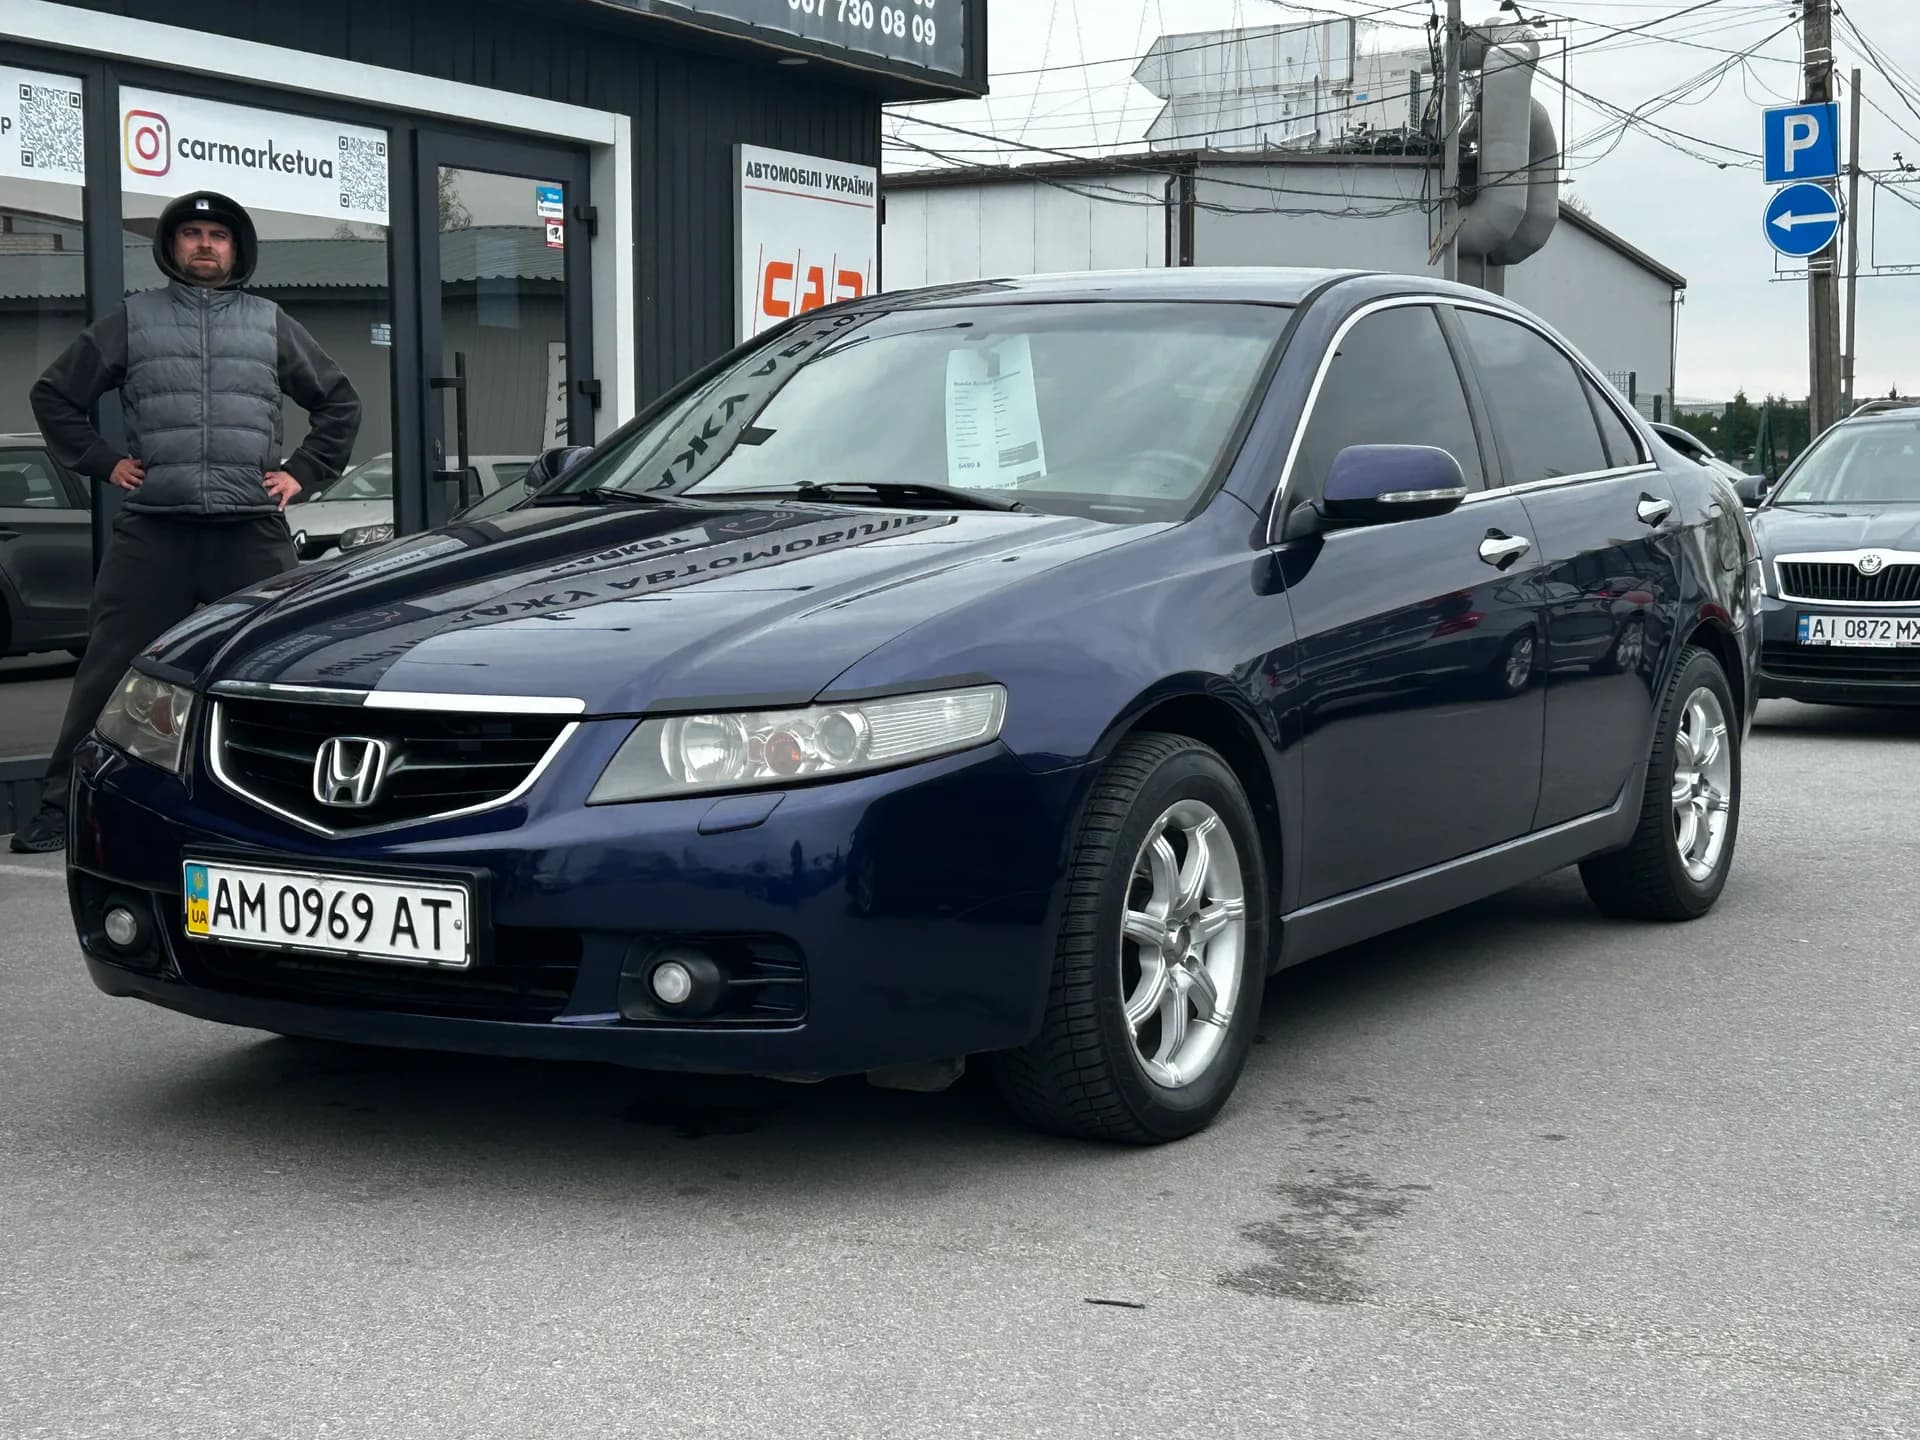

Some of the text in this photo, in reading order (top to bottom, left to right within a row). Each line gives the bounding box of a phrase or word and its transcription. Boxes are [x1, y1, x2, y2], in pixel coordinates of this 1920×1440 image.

[837, 0, 874, 30] 730
[880, 5, 906, 38] 08
[911, 14, 936, 46] 09
[177, 135, 334, 180] carmarketua
[1784, 114, 1819, 173] P
[746, 161, 874, 198] АВТОМОБІЛІ УКРАЇНИ
[1844, 620, 1892, 639] 0872
[191, 909, 208, 925] UA
[212, 877, 453, 951] AM 0969 AT
